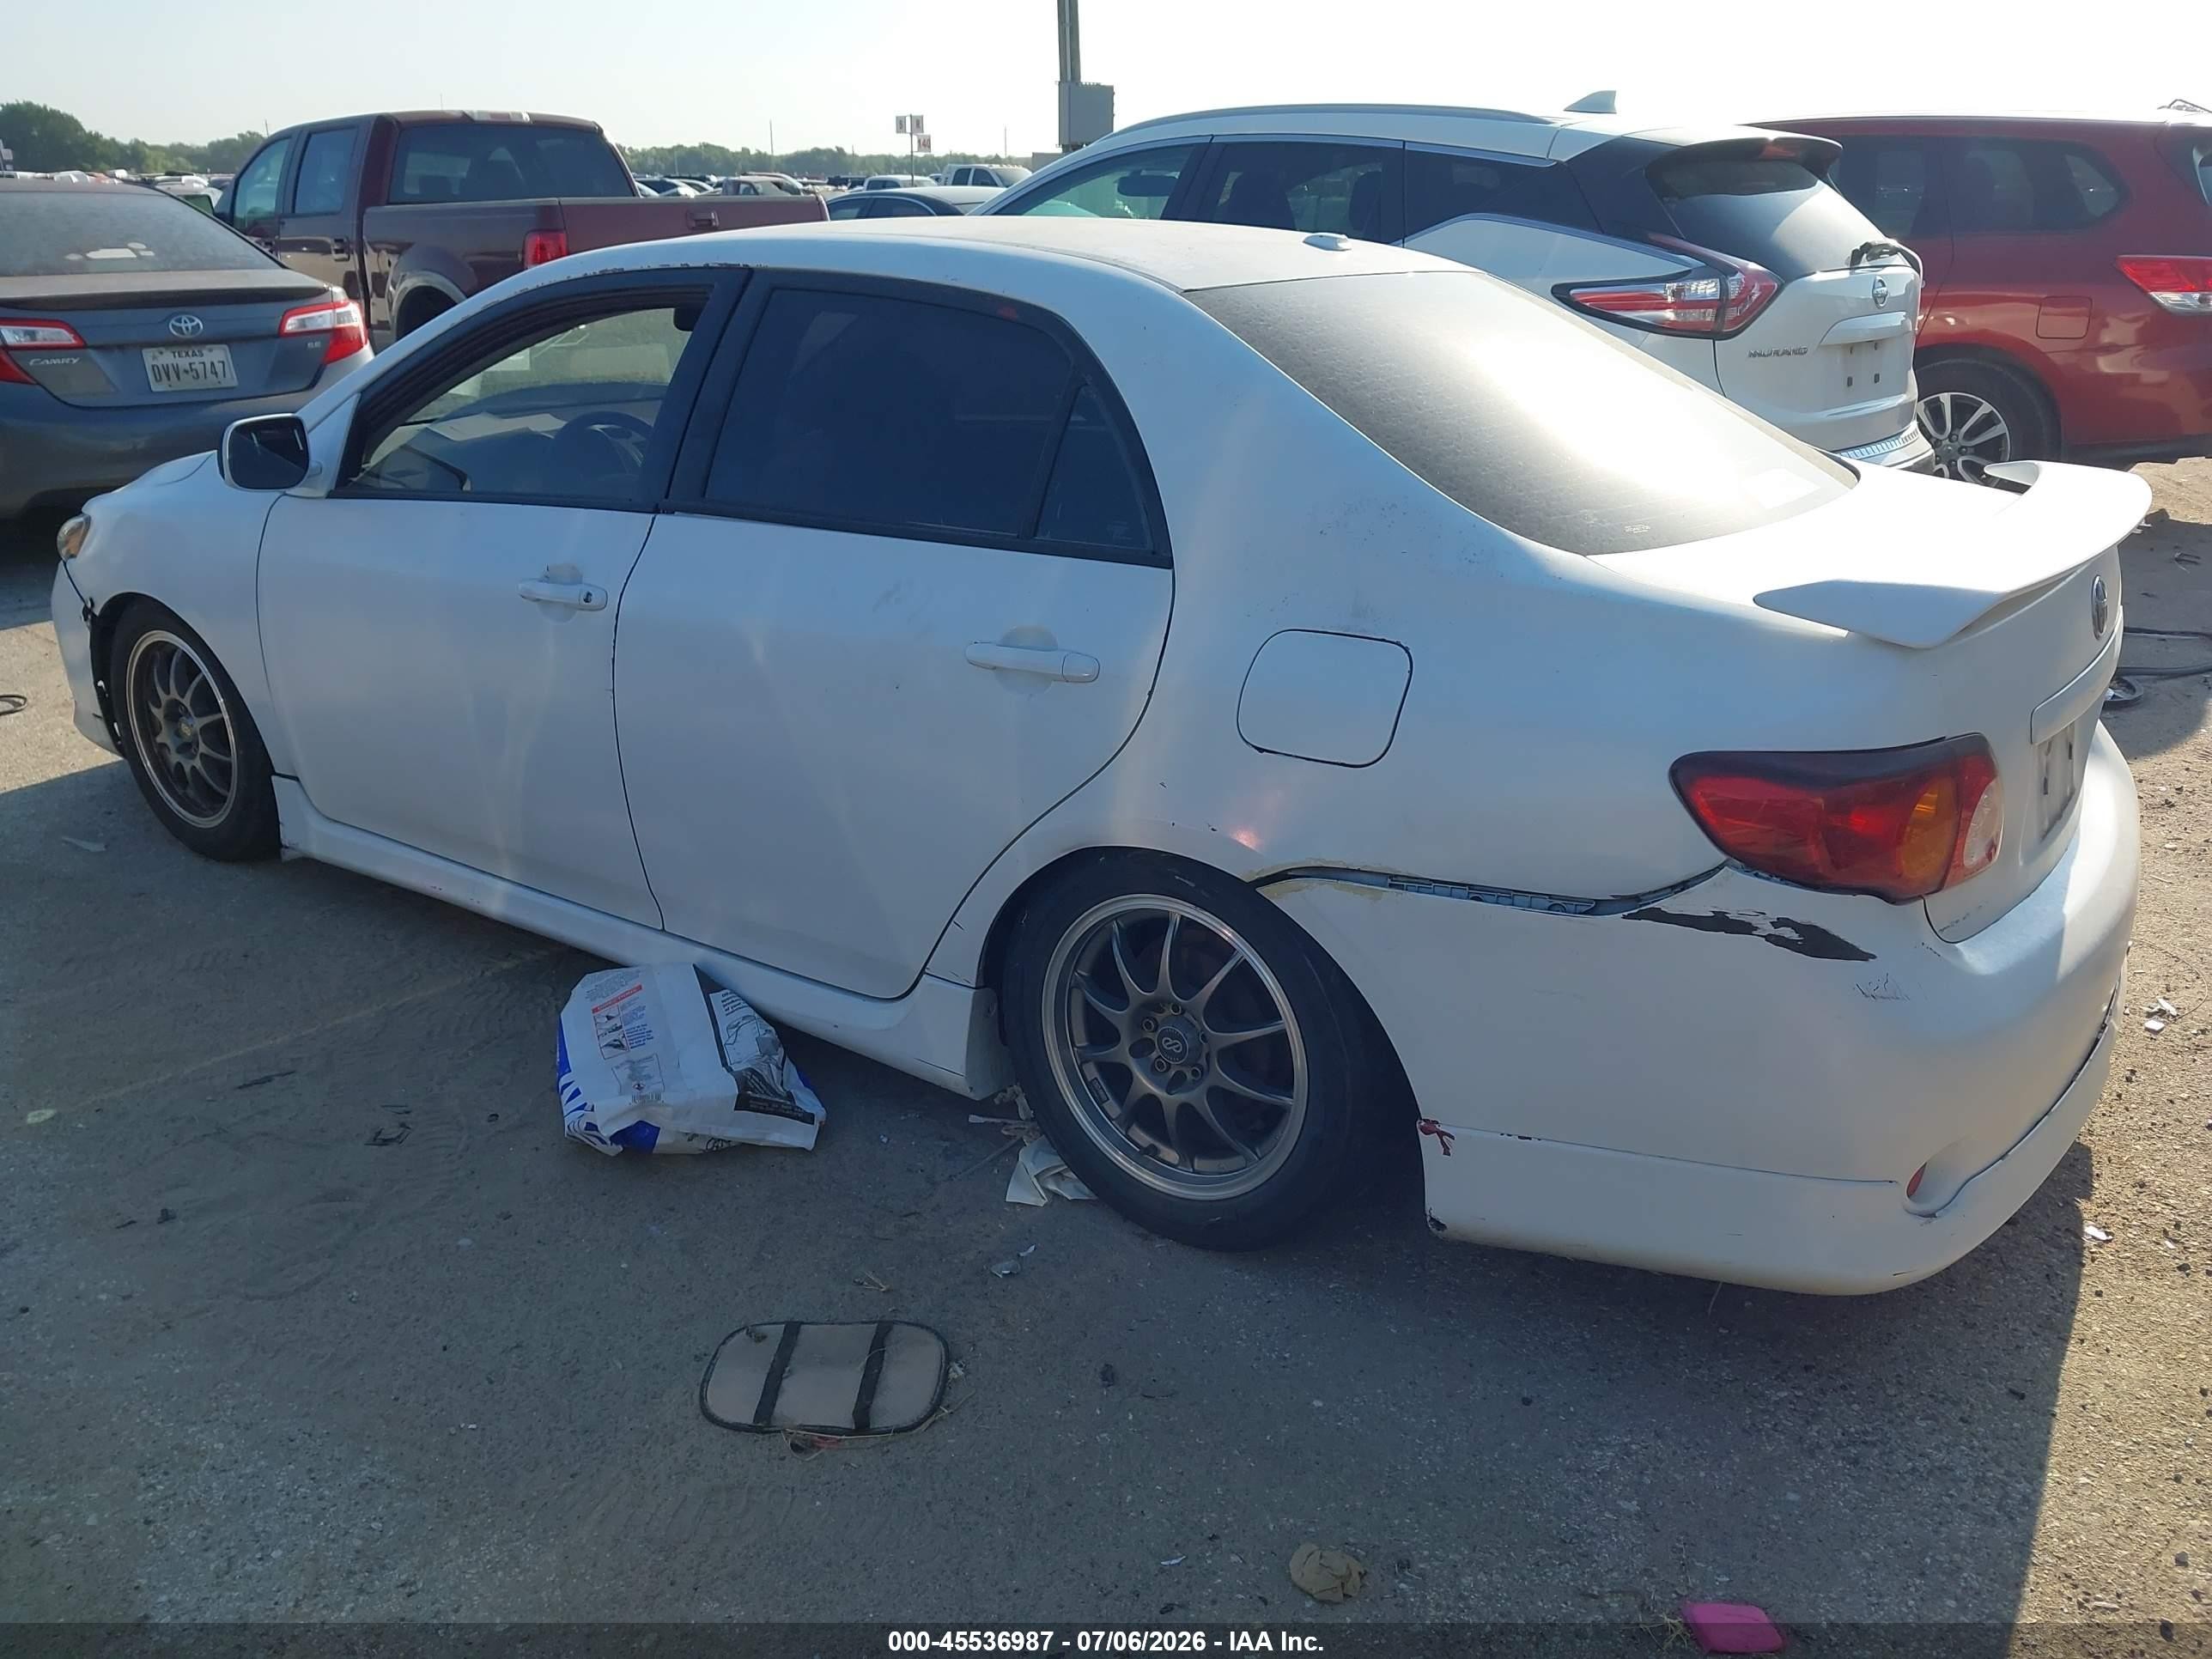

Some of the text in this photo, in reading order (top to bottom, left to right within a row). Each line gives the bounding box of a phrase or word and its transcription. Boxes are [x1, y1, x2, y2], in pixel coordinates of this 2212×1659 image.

[172, 349, 204, 359] TEXAS
[1747, 346, 1808, 357] MURANO
[29, 357, 81, 367] CAMRY
